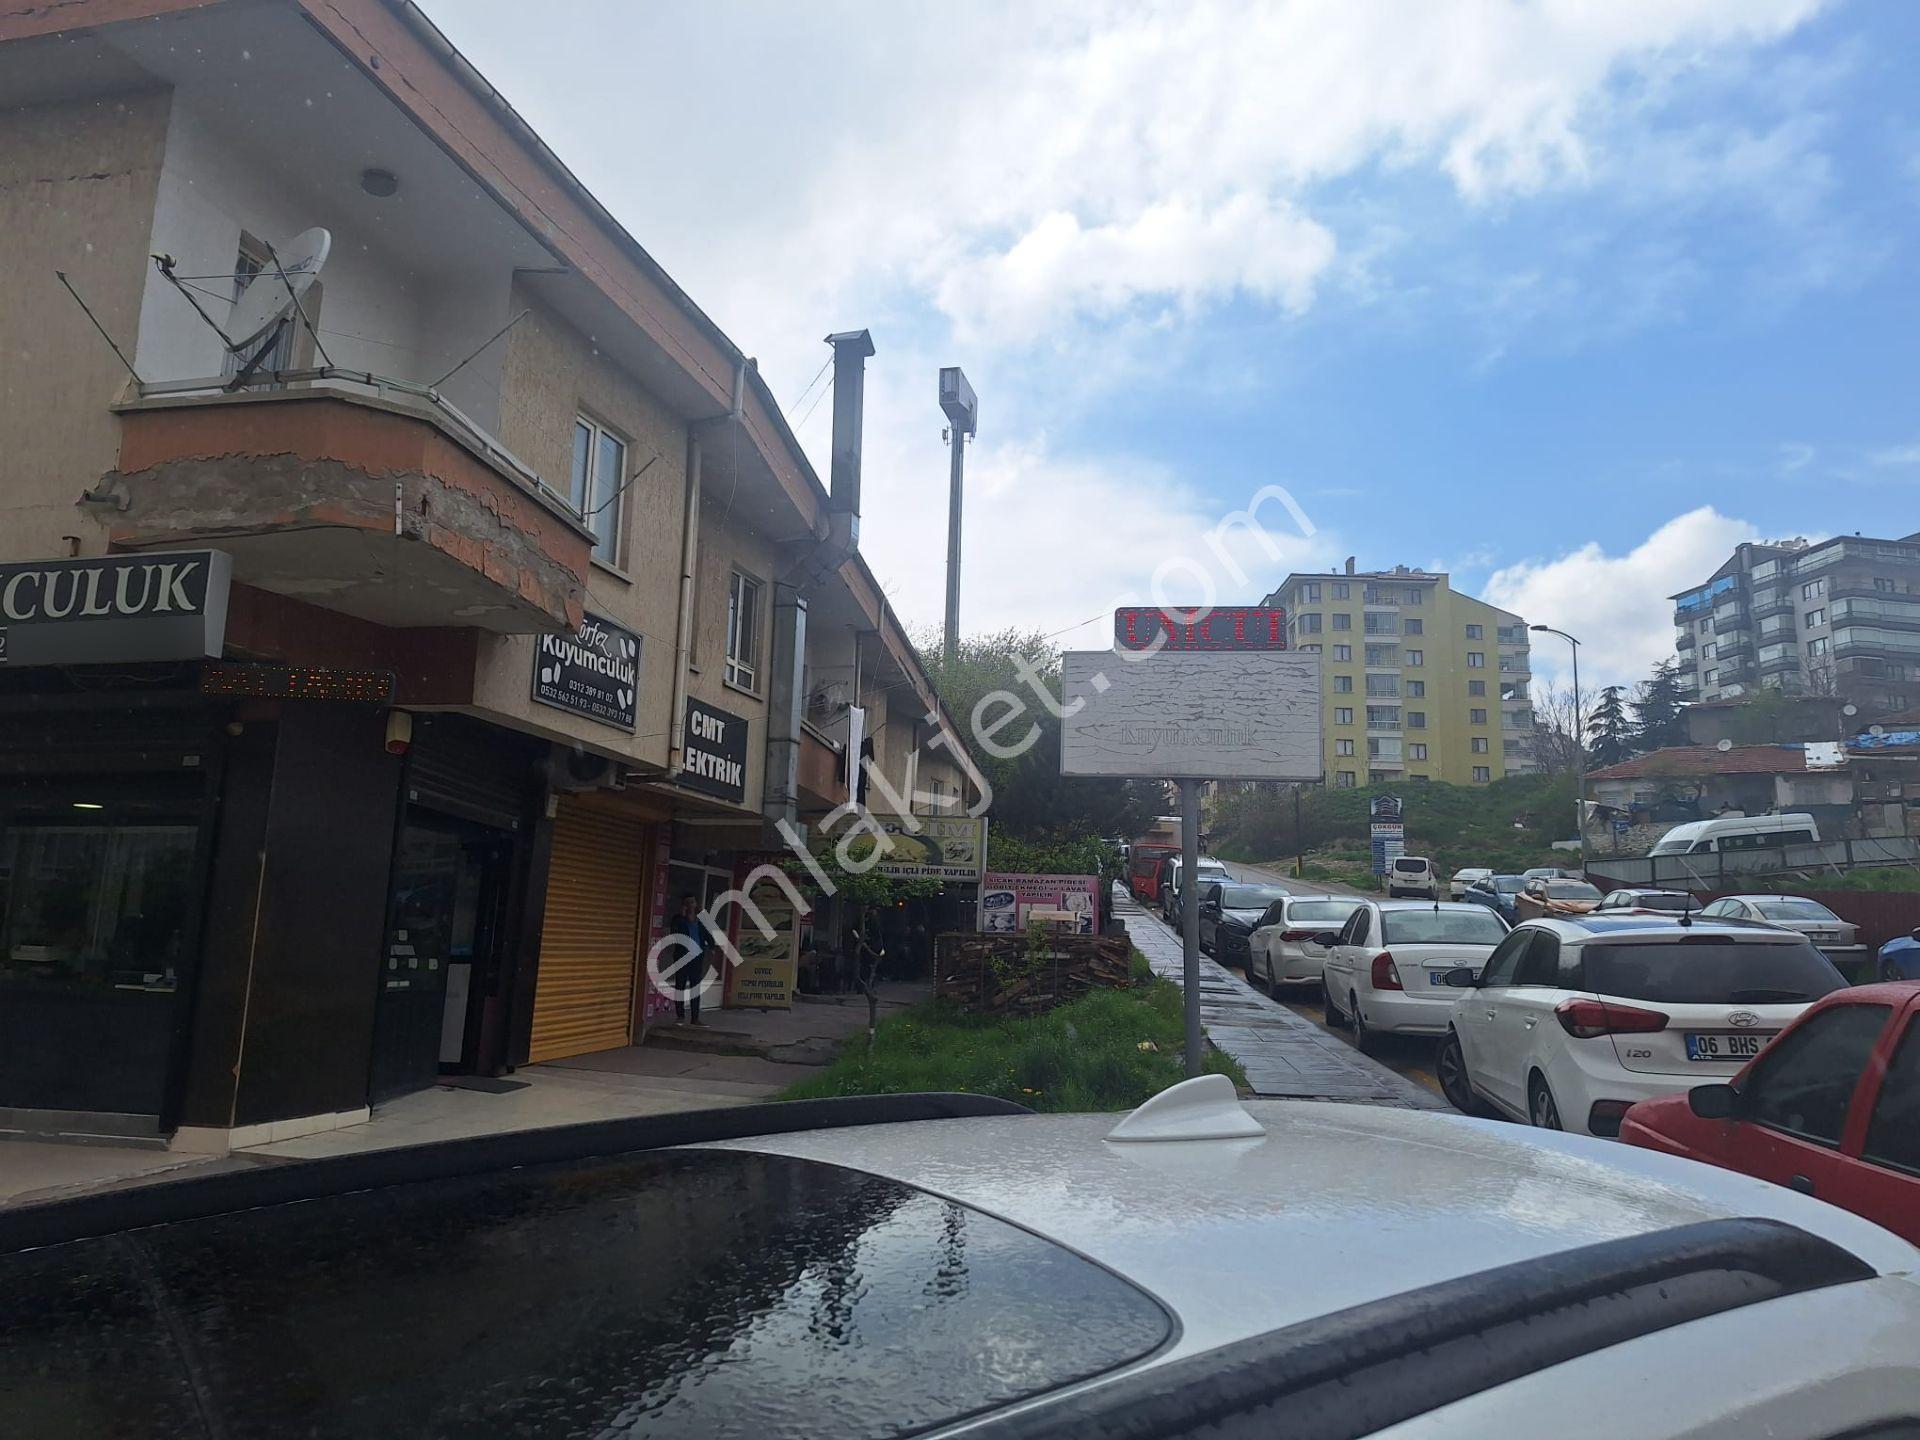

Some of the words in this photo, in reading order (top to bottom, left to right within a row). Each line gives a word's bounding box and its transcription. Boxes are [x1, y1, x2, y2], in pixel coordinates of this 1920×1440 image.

[0, 560, 200, 621] CULUK
[542, 633, 635, 687] Kuyumculuk
[540, 684, 557, 698] 0532
[558, 690, 569, 702] 562
[568, 680, 585, 693] 0312
[691, 710, 726, 744] CMT
[682, 747, 742, 787] EKTRİK
[1698, 1036, 1718, 1054] 06
[1728, 1036, 1759, 1054] BHS
